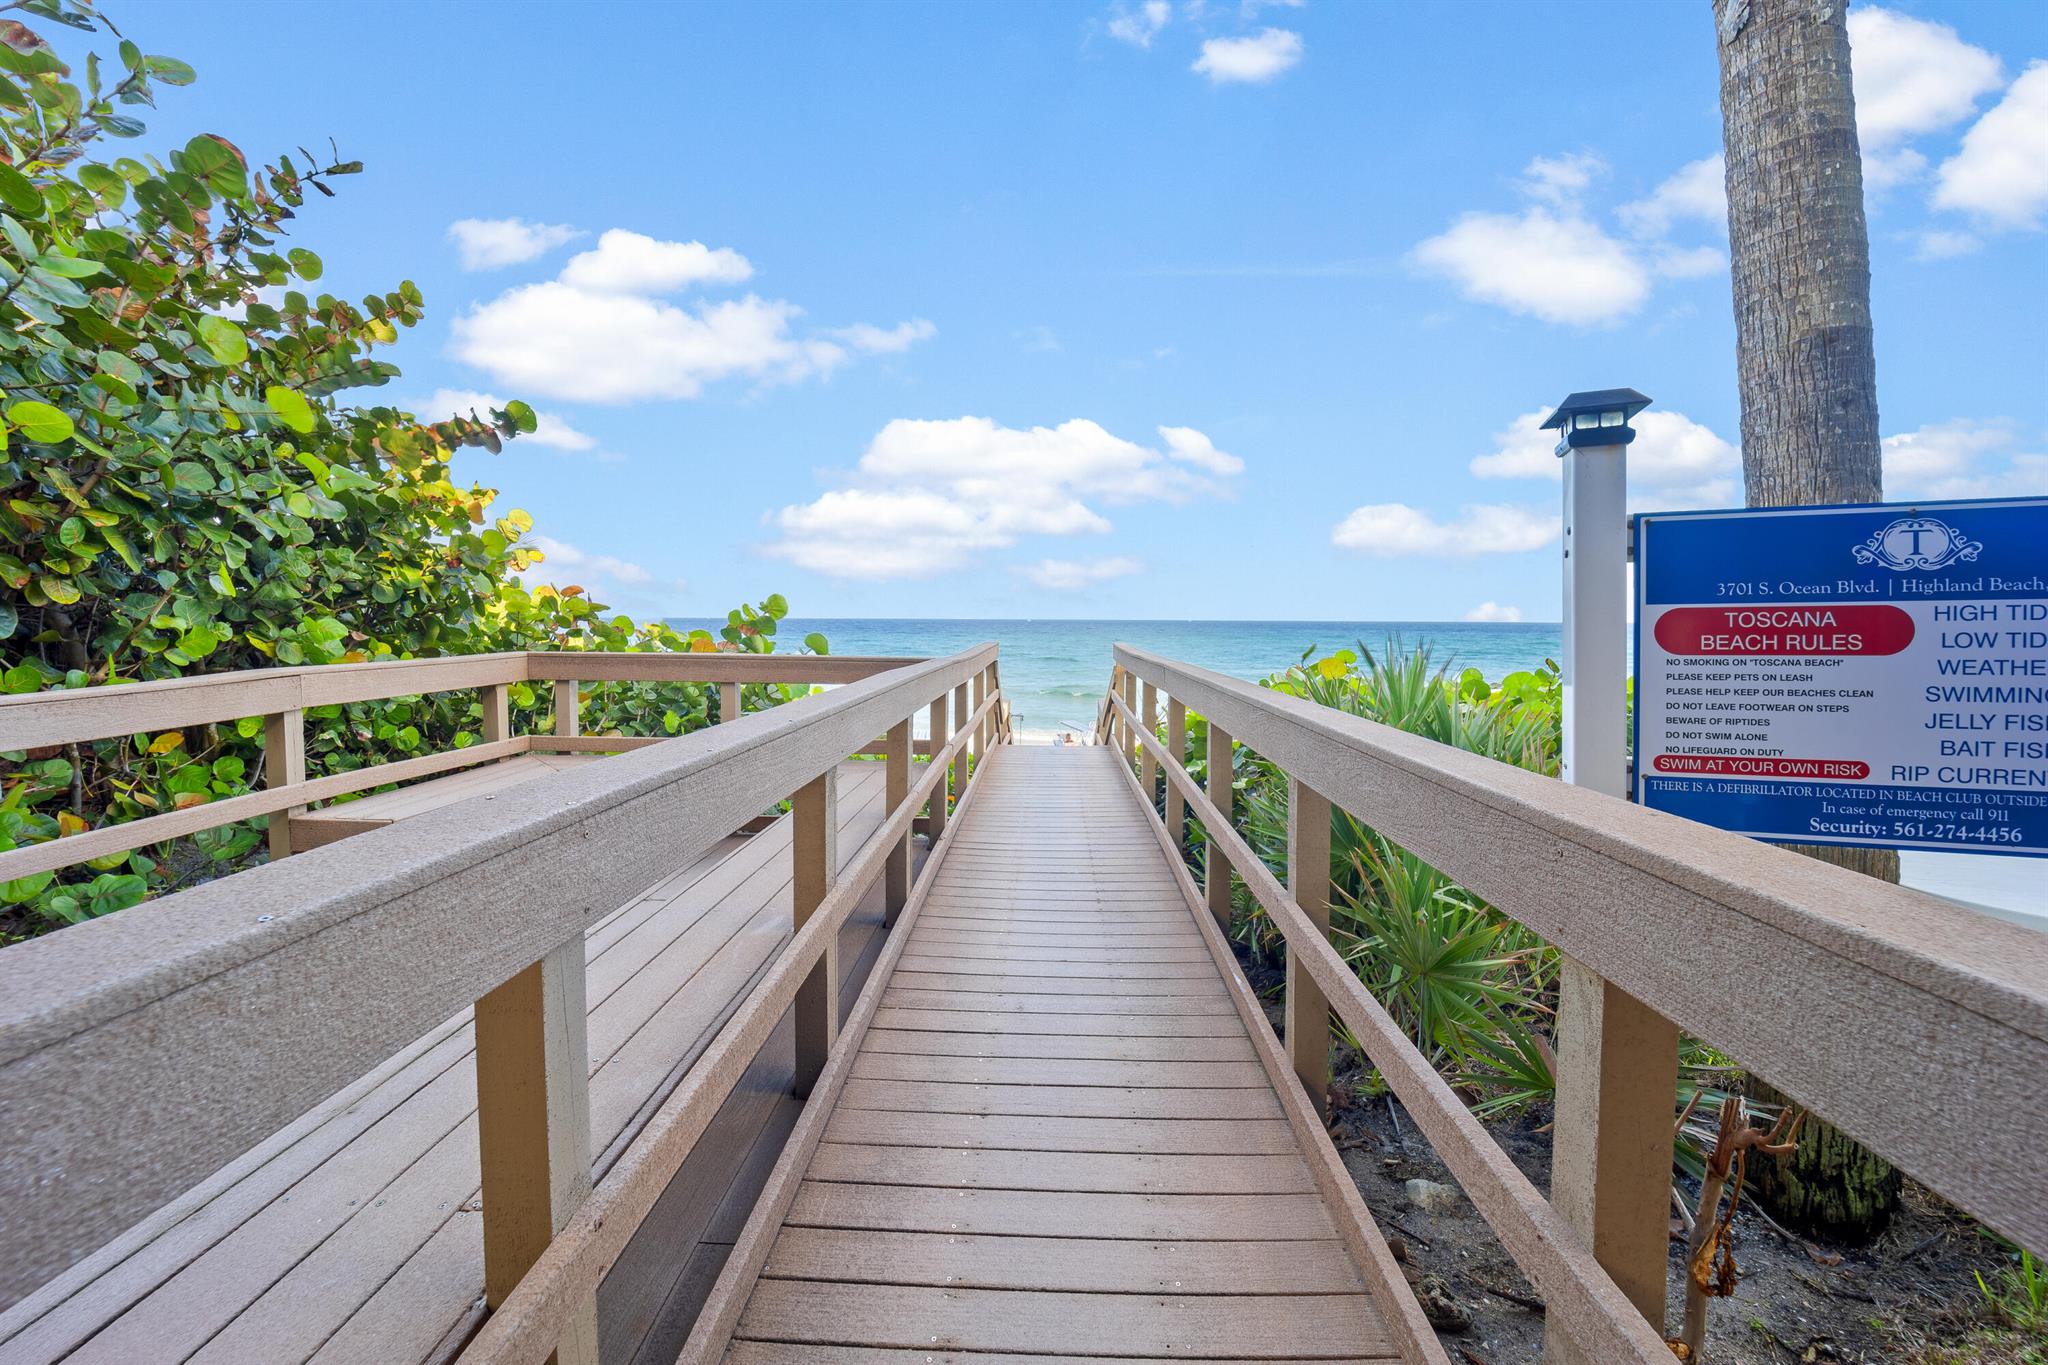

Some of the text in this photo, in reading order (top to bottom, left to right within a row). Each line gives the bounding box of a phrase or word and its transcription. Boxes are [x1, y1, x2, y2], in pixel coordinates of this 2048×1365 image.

[1716, 582, 1753, 596] 3701
[1759, 582, 1774, 595] S.
[1779, 581, 1831, 595] Ocean
[1837, 579, 1880, 594] Blvd.
[1902, 577, 1983, 595] Highland
[1724, 611, 1837, 628] TOSCANA
[1934, 604, 2048, 621] HIGH TID
[1700, 634, 1863, 651] BEACH RULES
[1942, 632, 2048, 648] LOW TID
[1666, 658, 1844, 667] NO SMOKING ON "TOSCANA BEACH"
[1937, 659, 2047, 676] WEATHE
[1666, 673, 1813, 682] PLEASE KEEP PETS ON LEASH
[1666, 687, 1874, 698] PLEASE HELP KEEP OUR BEACHES CLEAN
[1925, 685, 2048, 704] SWIMMIN
[1666, 702, 1850, 713] DO NOT LEAVE FOOTWEAR ON STEPS
[1665, 717, 1770, 726] BEWARE OF RIPTIDES
[1924, 713, 2048, 732] JELLY FIS
[1665, 731, 1768, 741] DO NOT SWIM ALONE
[1665, 746, 1784, 756] NO LIFEGUARD ON DUTY
[1941, 740, 2048, 759] BAIT FIS
[1660, 758, 1862, 776] SWIM AT YOUR OWN RISK
[1891, 765, 2048, 787] RIP CURREN
[1651, 780, 2048, 807] THERE IS A DEFIBRILLATOR LOCATED IN BEACH CLUB OUTSIDE
[1822, 802, 2009, 822] In case of emergency call 911
[1809, 817, 2023, 843] Security: 561-274-4456
